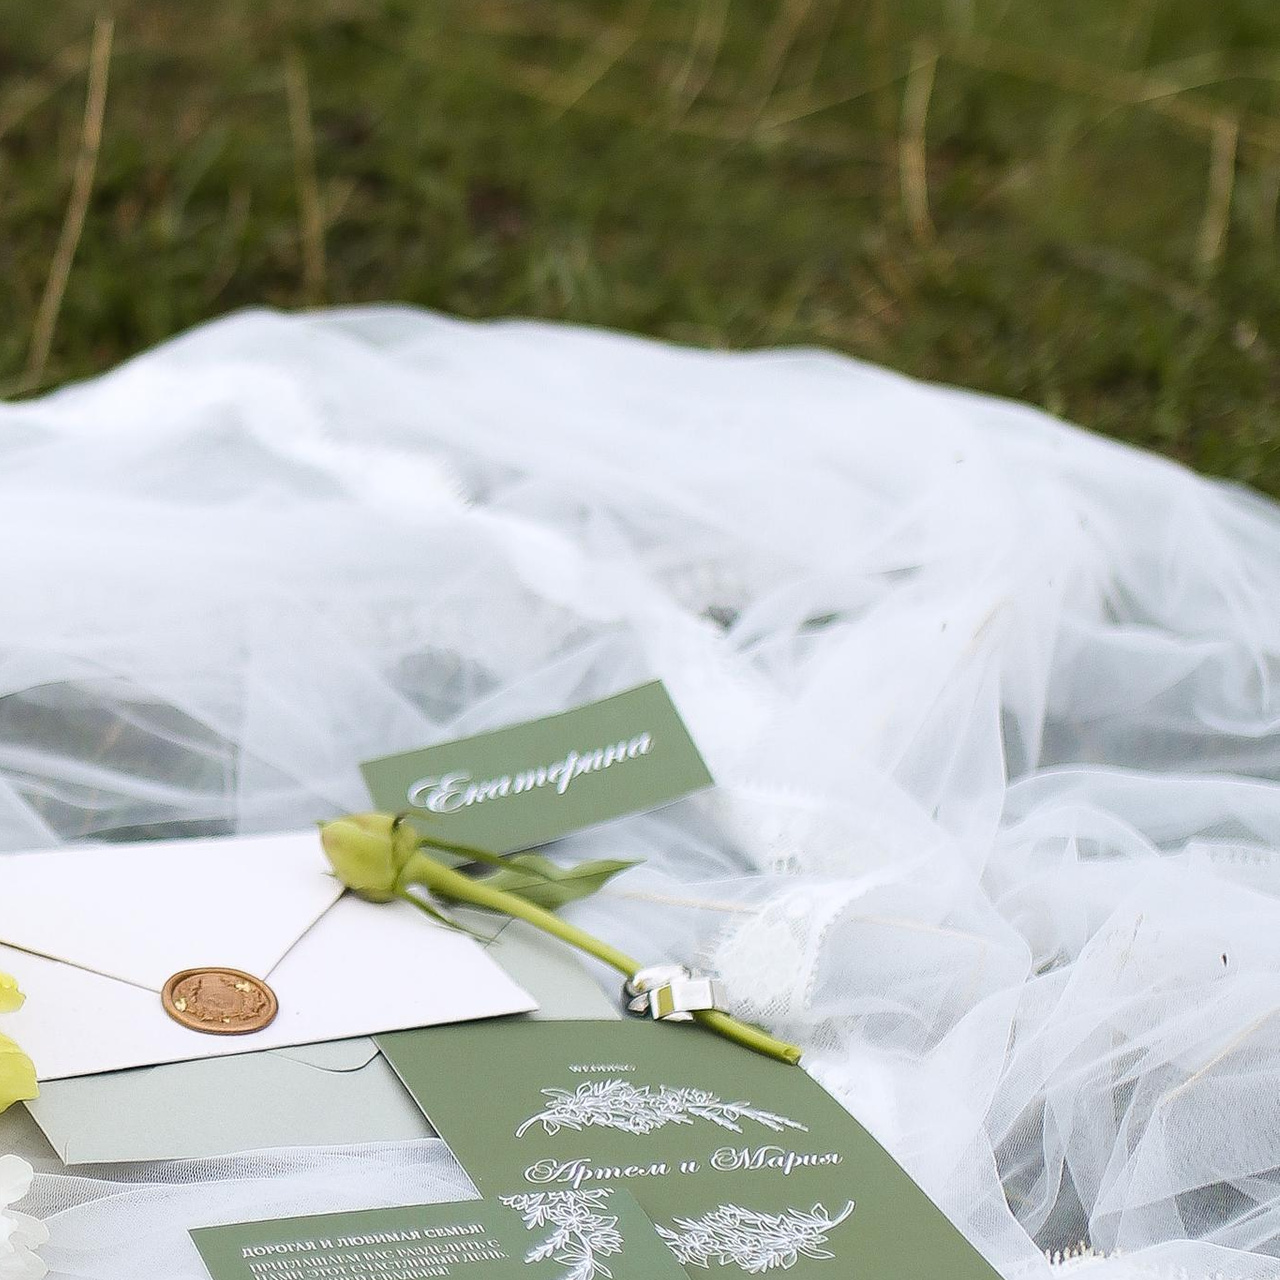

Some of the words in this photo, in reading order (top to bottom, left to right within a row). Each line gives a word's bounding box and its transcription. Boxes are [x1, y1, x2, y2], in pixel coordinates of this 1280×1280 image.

[407, 731, 655, 814] Екатерина
[524, 1158, 671, 1189] Артем
[680, 1161, 701, 1174] и
[710, 1145, 843, 1176] Мария
[242, 1241, 317, 1258] ДОРОГАЯ
[319, 1239, 333, 1249] И
[337, 1230, 421, 1248] ЛЮБИМАЯ
